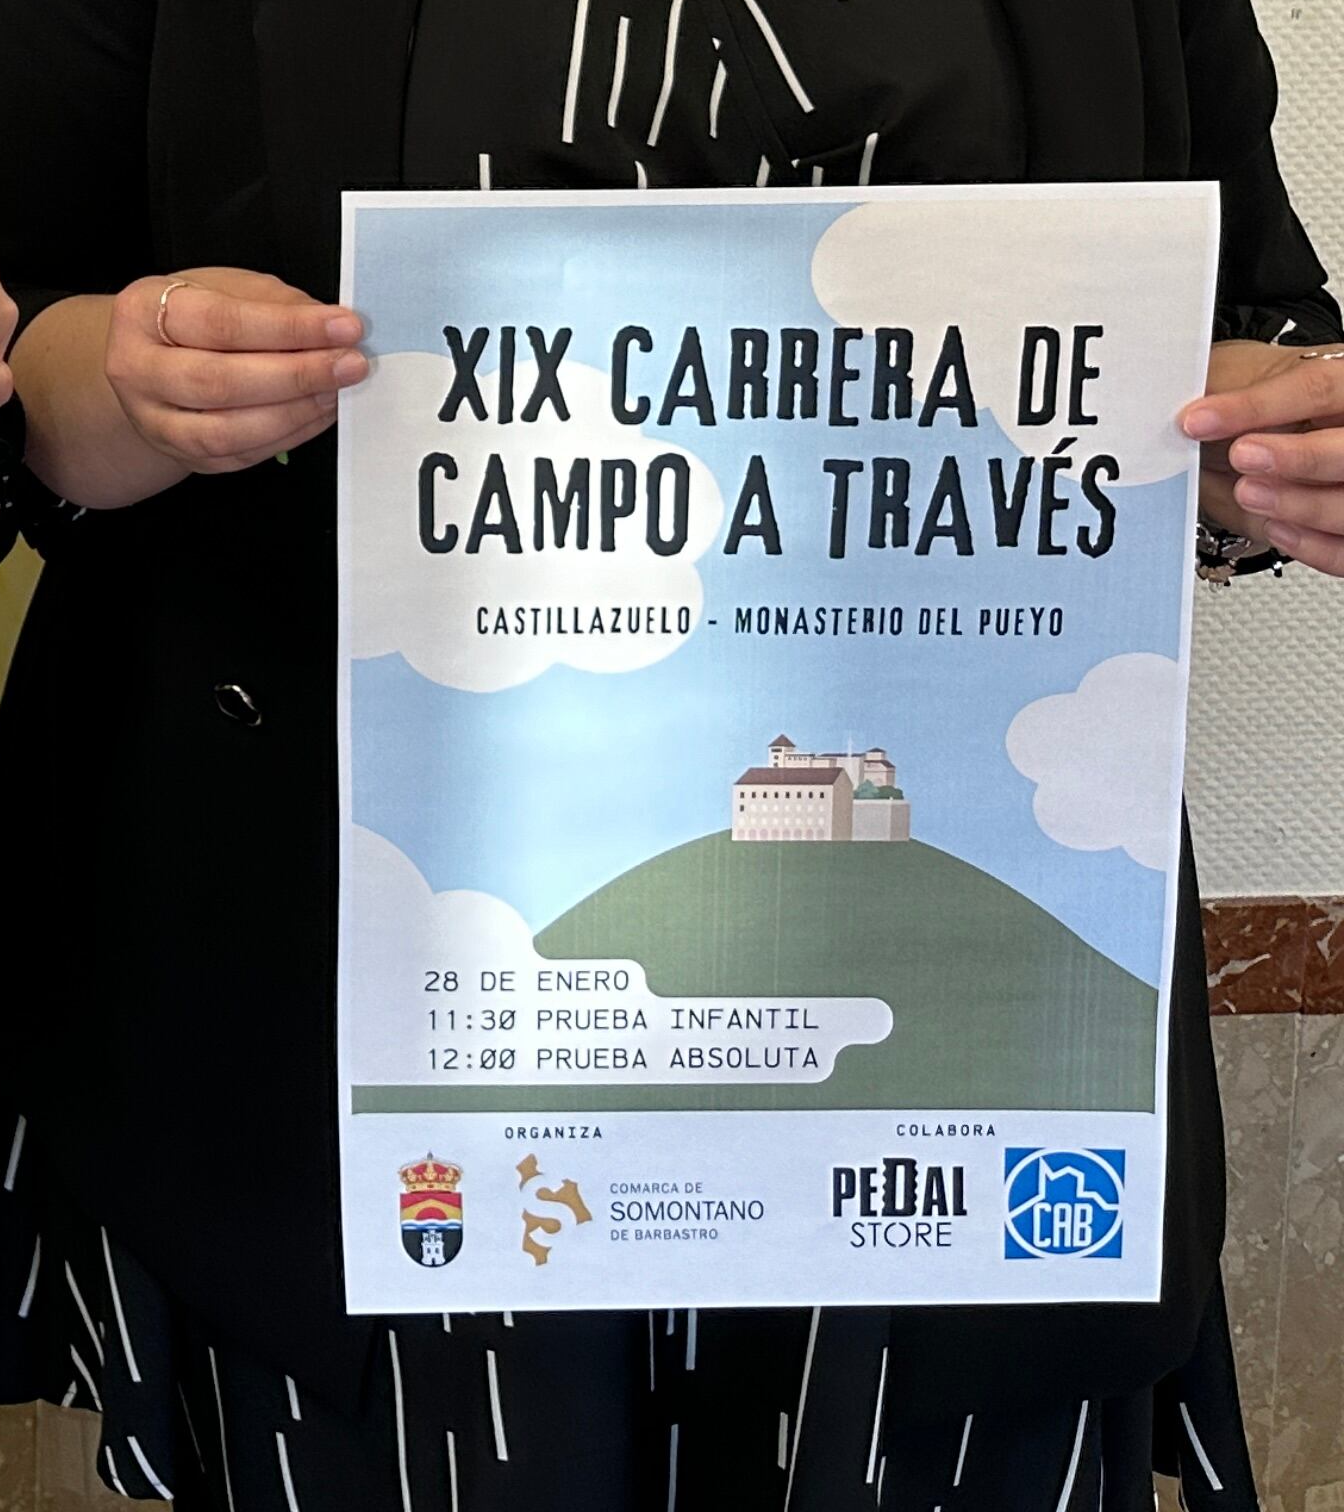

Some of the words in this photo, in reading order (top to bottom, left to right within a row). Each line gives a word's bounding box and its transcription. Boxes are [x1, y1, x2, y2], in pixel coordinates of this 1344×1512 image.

[437, 325, 573, 425] XIX
[611, 325, 979, 428] CARRERA
[1017, 325, 1104, 426] DE
[418, 451, 691, 557] CAMPO
[723, 454, 783, 556] A
[823, 436, 1120, 560] TRAVÉS
[477, 606, 690, 636] CASTILLAZUELO
[735, 606, 903, 636] MONASTERIO
[918, 607, 963, 636] DEL
[979, 607, 1063, 637] PUEYO
[424, 970, 459, 992] 28
[480, 971, 515, 992] DE
[537, 969, 629, 992] ENERO
[428, 1009, 516, 1031] 11:30
[537, 1008, 648, 1030] PRUEBA
[671, 1008, 820, 1030] INFANTIL
[429, 1048, 516, 1070] 12:00
[537, 1047, 648, 1070] PRUEBA
[670, 1046, 819, 1069] ABSOLUTA
[504, 1126, 602, 1140] ORGANIZA
[896, 1124, 996, 1137] COLABORA
[609, 1182, 679, 1195] COMARCA
[684, 1181, 703, 1194] DE
[833, 1157, 968, 1218] PEDAL
[610, 1200, 764, 1222] SOMONTANO
[610, 1228, 629, 1241] DE
[634, 1228, 719, 1241] BARBASTRO
[850, 1221, 952, 1248] STORE
[1032, 1201, 1093, 1247] CAB
